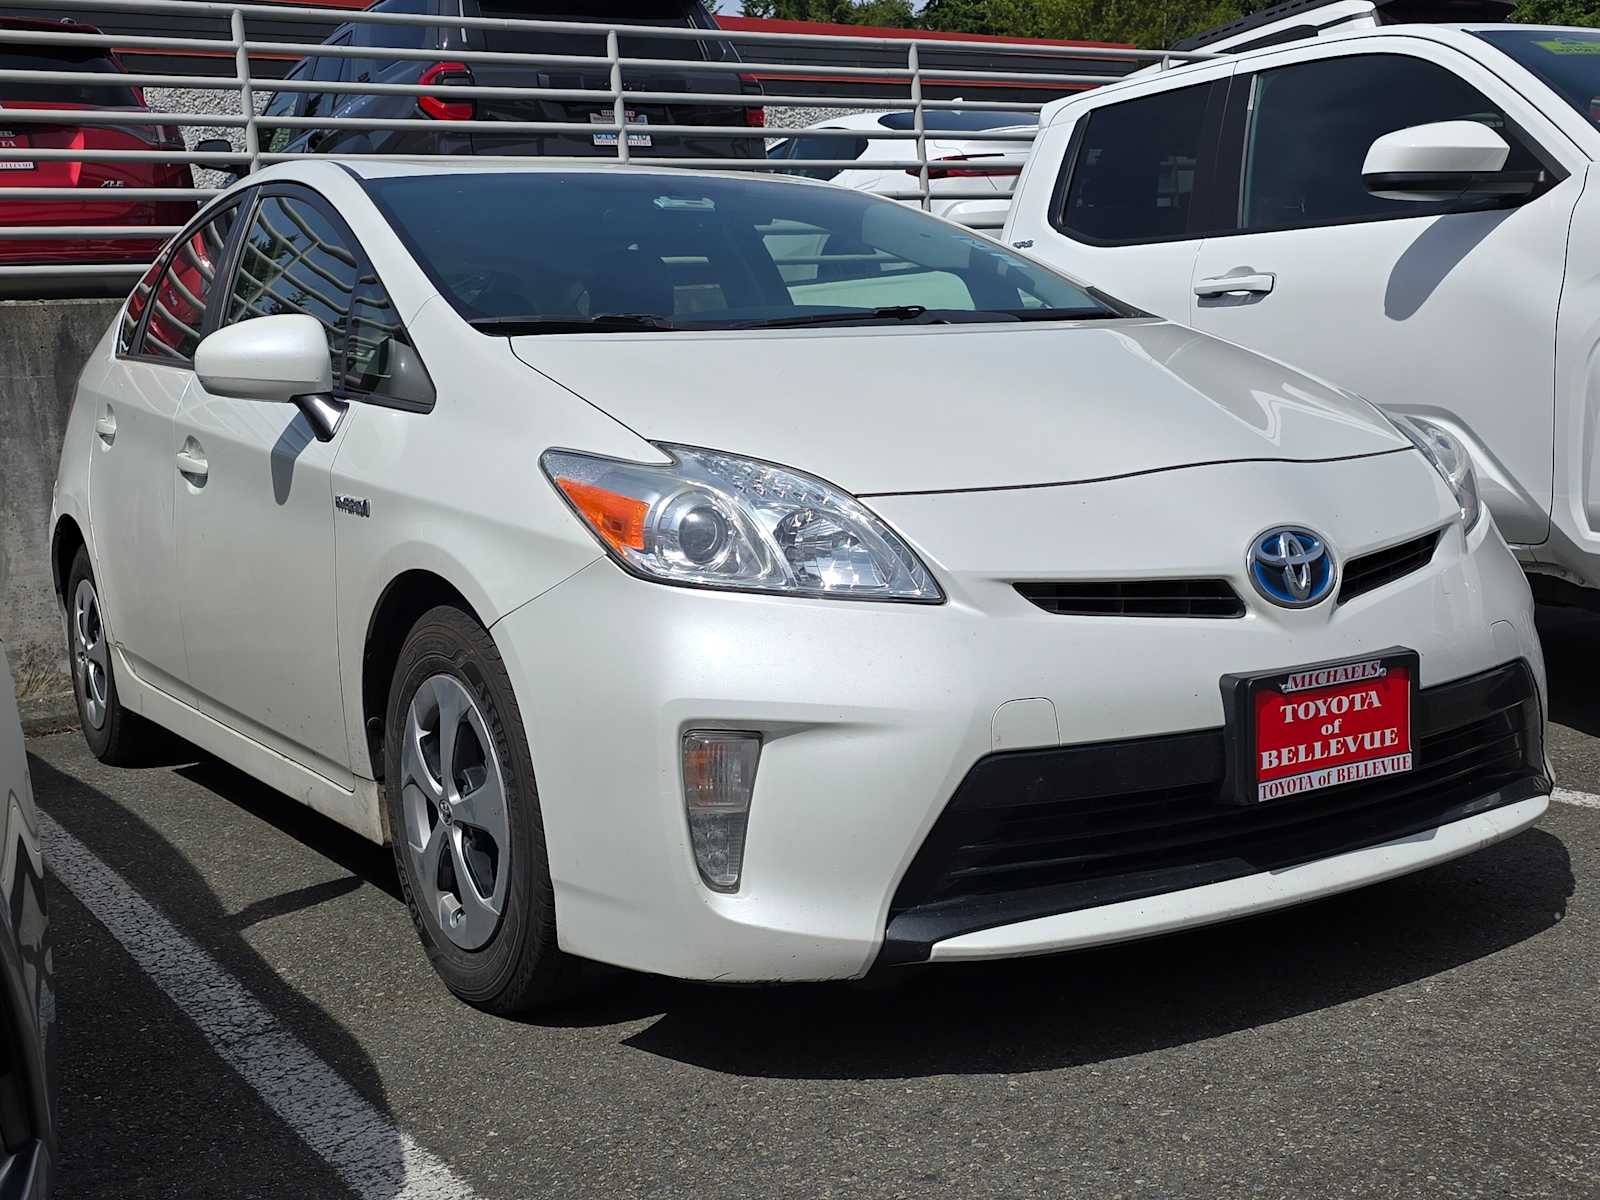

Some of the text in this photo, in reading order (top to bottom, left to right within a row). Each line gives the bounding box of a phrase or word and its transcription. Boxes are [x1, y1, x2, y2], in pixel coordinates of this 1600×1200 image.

[1289, 662, 1379, 690] MICHAELS
[1280, 690, 1382, 723] TOYOTA
[1320, 719, 1342, 736] of
[1261, 727, 1399, 770] BELLEVUE
[1261, 755, 1411, 801] TOYOTA of BELLEVUE
